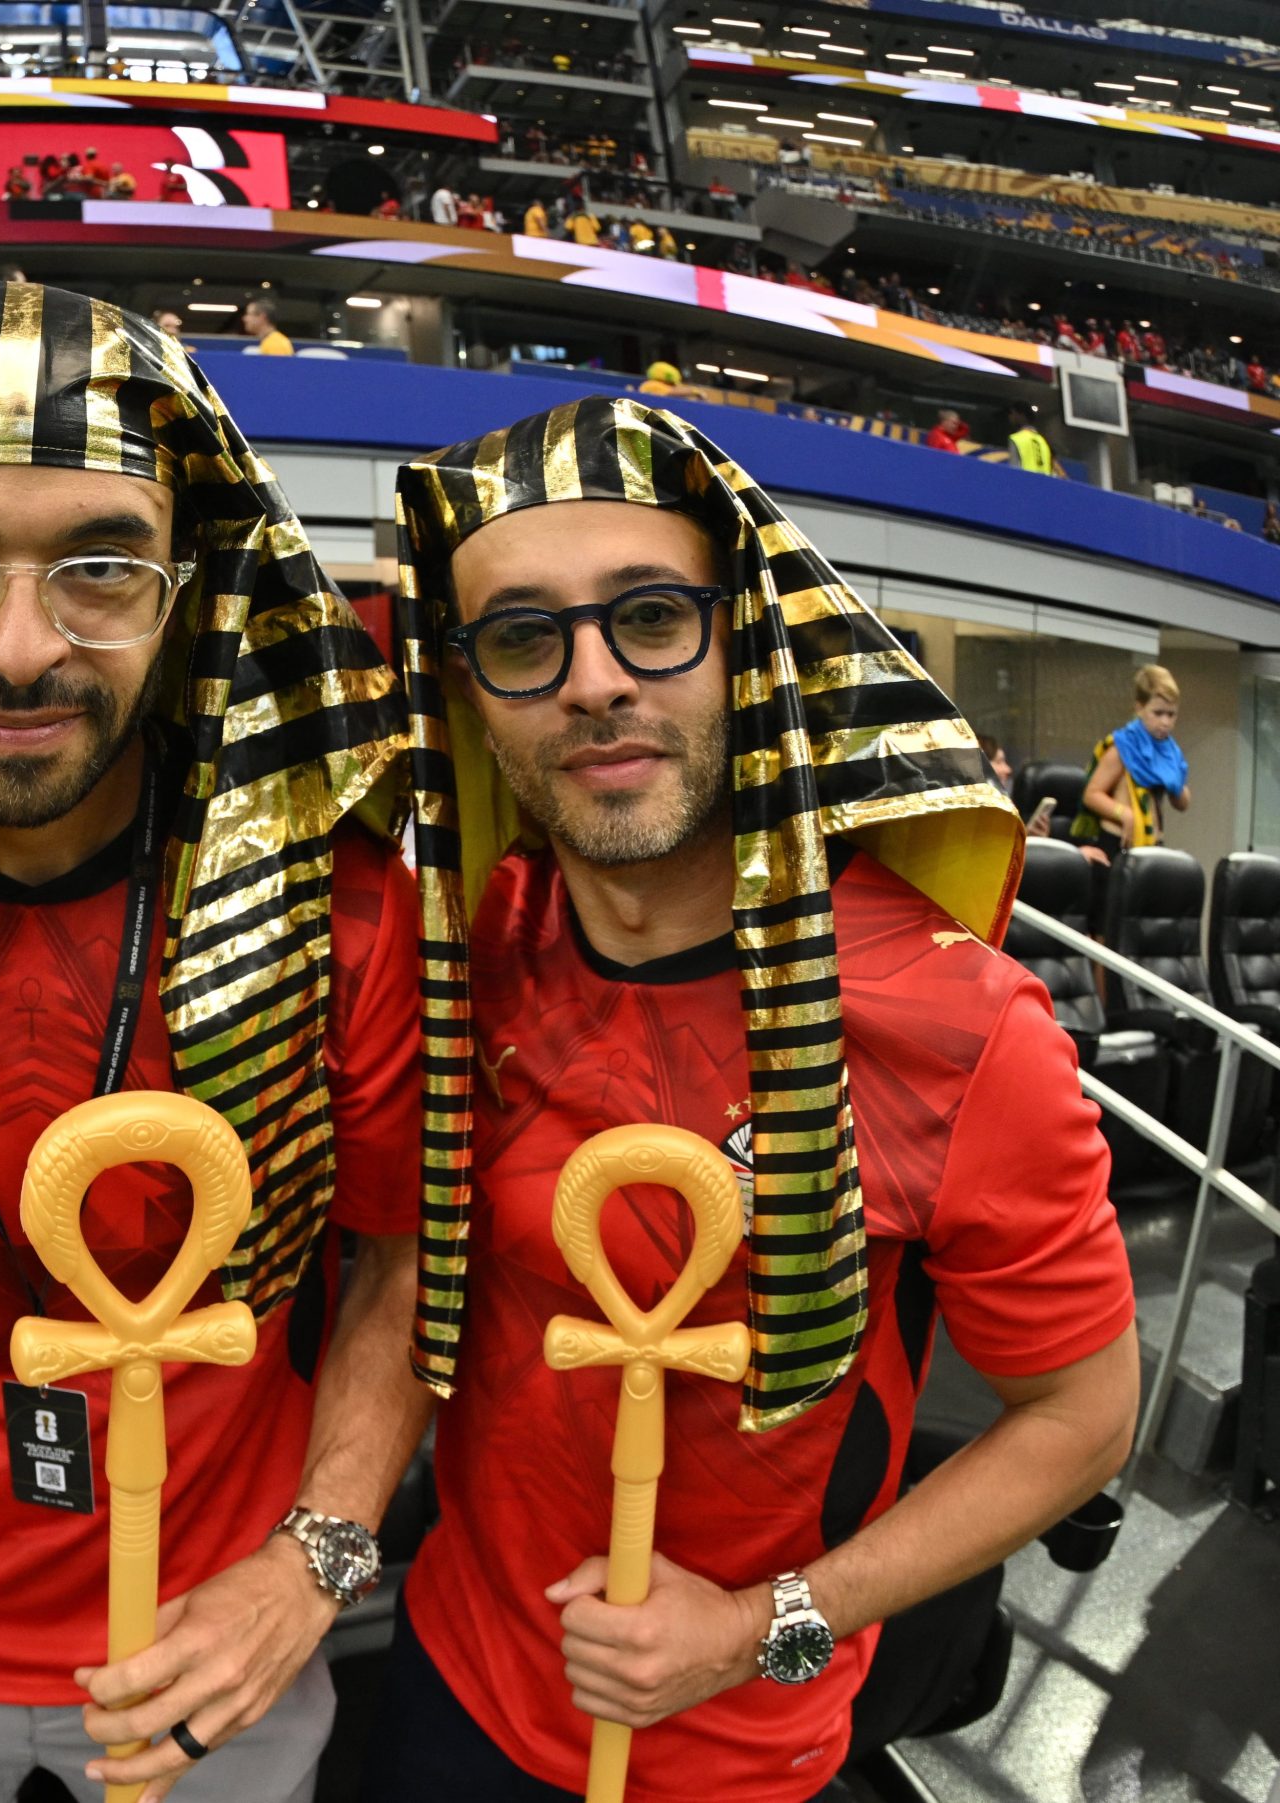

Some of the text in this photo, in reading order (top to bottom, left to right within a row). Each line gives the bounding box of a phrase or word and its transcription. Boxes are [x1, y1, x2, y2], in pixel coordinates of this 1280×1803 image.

[1000, 12, 1108, 40] DALLAS
[136, 903, 144, 930] WORLD
[133, 930, 141, 946] CUP
[104, 1007, 129, 1094] FIFA WORLD CUP 2026
